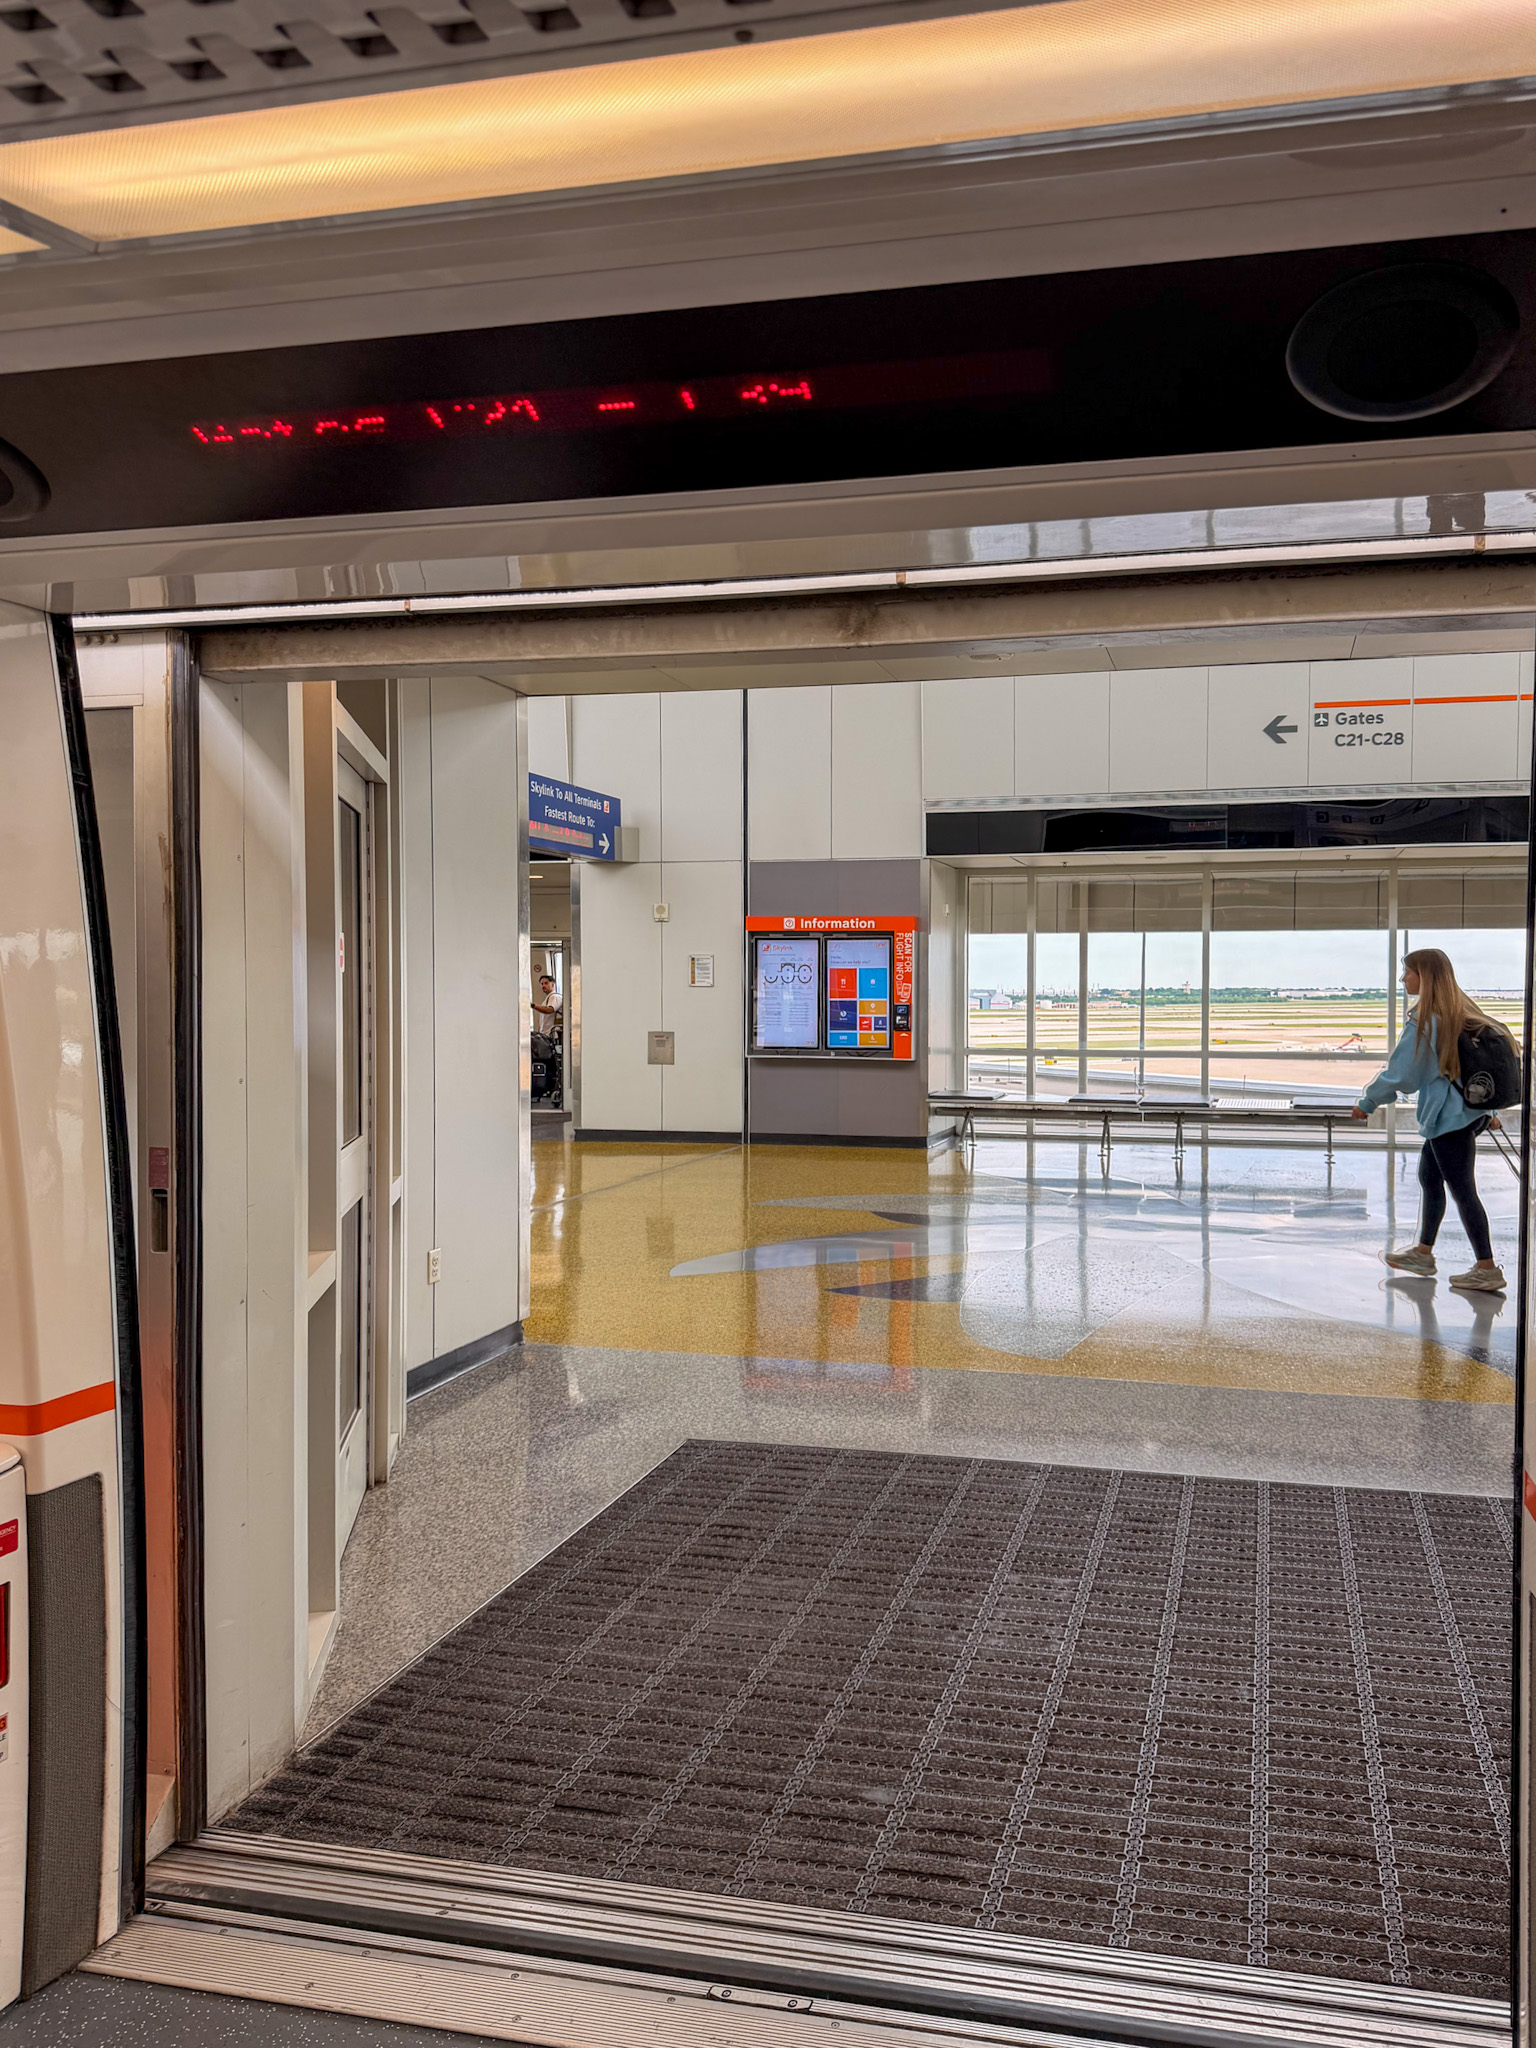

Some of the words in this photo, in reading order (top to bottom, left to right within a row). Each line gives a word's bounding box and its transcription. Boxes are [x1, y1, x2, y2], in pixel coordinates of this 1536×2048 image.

[1335, 711, 1384, 725] Gates
[1334, 732, 1404, 747] C21-C28
[530, 780, 555, 797] Skylink
[555, 787, 563, 800] To
[564, 790, 573, 803] All
[574, 793, 602, 811] Terminals
[544, 805, 567, 822] Fastest
[568, 811, 586, 826] Route
[586, 816, 596, 828] To:
[800, 917, 876, 930] Information
[896, 932, 904, 960] FLIGHT
[904, 932, 912, 955] SCAN
[896, 961, 904, 981] INFO
[904, 956, 912, 972] FOR
